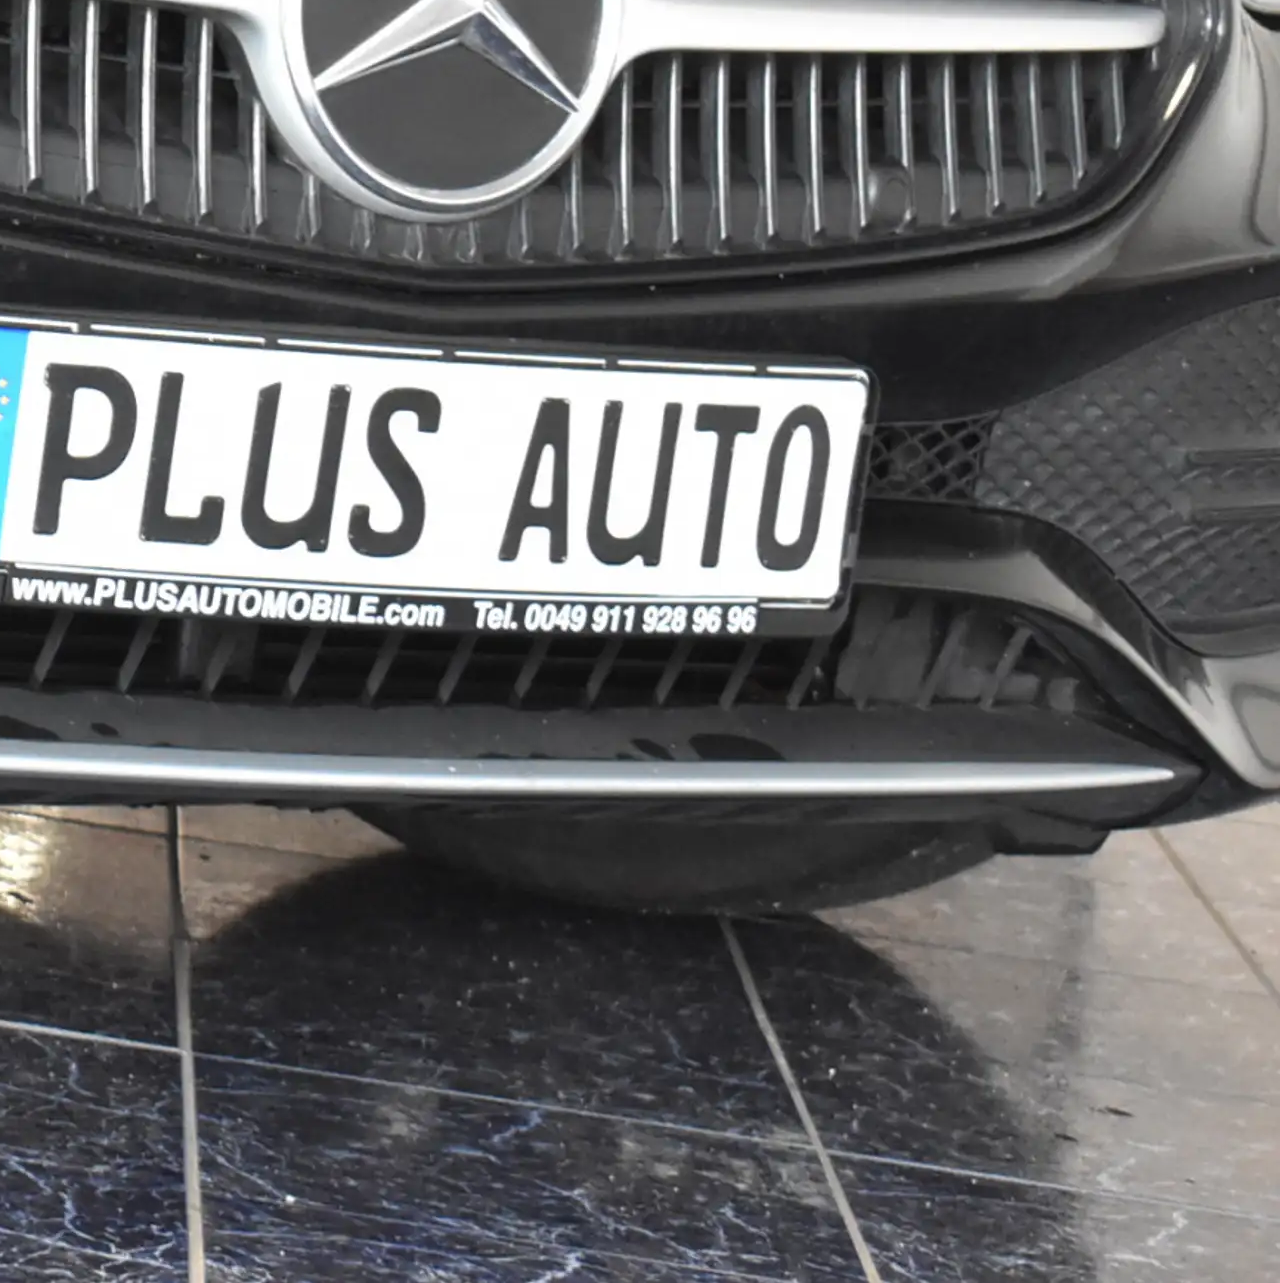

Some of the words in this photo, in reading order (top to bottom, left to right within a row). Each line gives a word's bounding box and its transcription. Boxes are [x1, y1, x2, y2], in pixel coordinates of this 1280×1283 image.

[32, 362, 442, 559] PLUS
[497, 397, 832, 572] AUTO
[11, 576, 445, 628] www.PLUSAUTOMOBILE.com
[473, 600, 518, 631] Tel.
[524, 602, 587, 632] 0049
[591, 604, 636, 633] 911
[642, 605, 688, 634] 928
[691, 606, 722, 634] 96
[726, 606, 757, 634] 96
